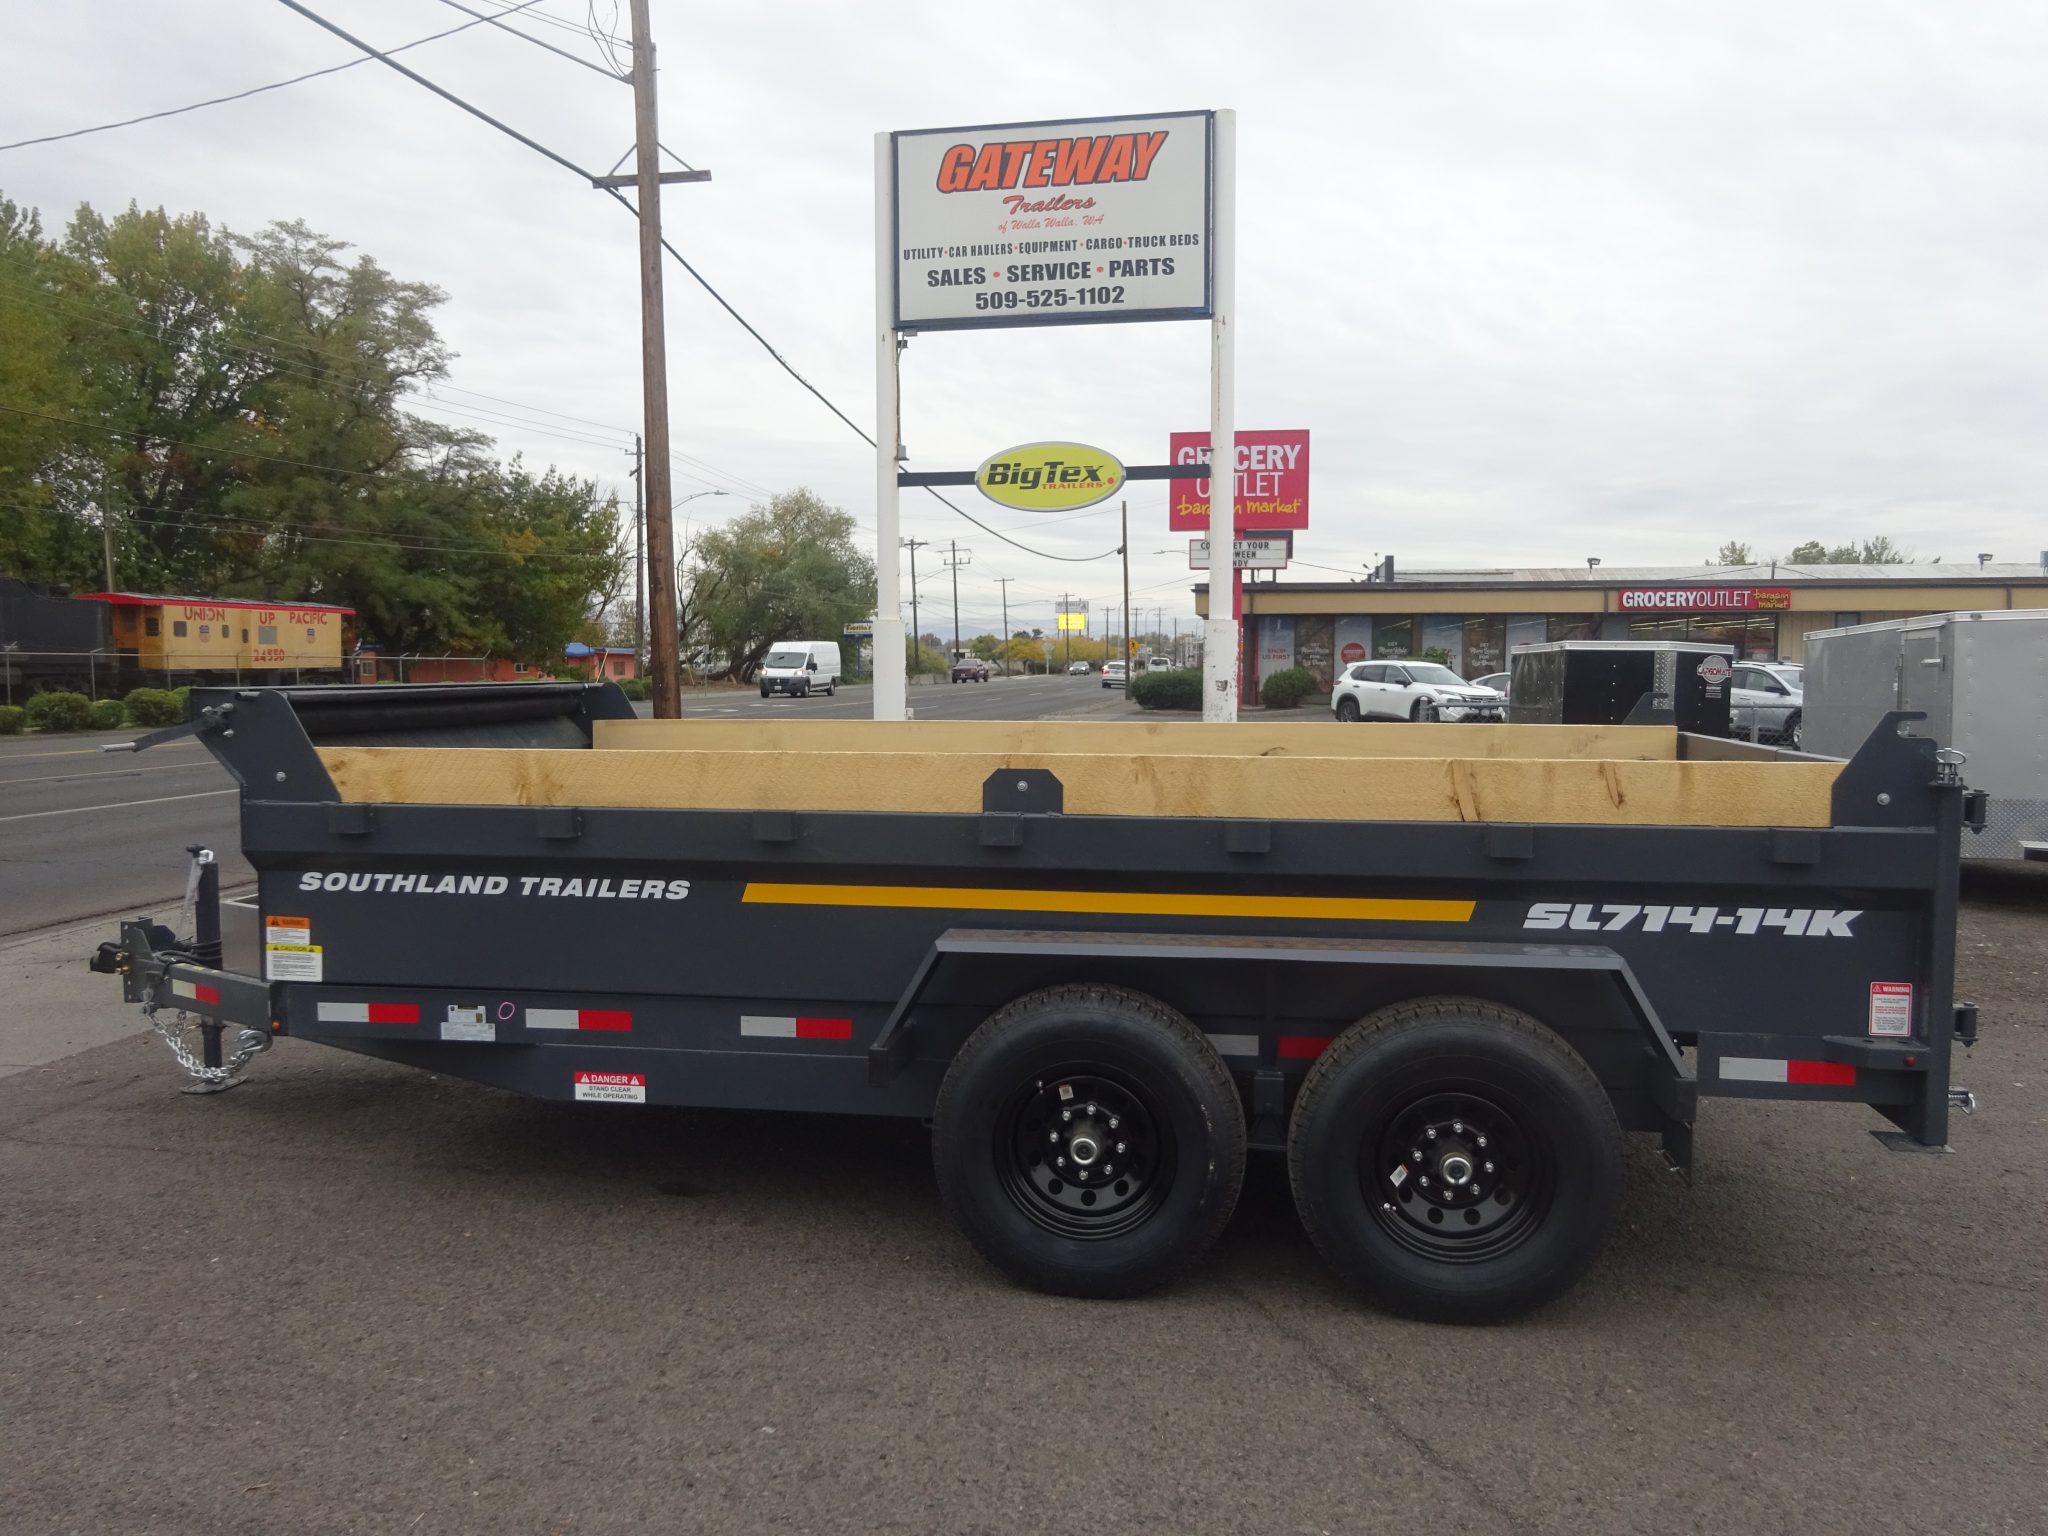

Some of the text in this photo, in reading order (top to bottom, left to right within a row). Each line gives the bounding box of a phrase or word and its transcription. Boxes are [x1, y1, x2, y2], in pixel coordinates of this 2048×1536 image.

[936, 130, 1169, 194] GATEWAY
[1003, 193, 1096, 215] Trailers
[998, 221, 1008, 233] of
[1010, 219, 1040, 231] Walla
[1082, 214, 1105, 226] WA
[948, 246, 968, 258] CAR
[970, 243, 1013, 257] HAULERS
[1018, 240, 1077, 254] EQUIPMENT
[1085, 237, 1122, 250] CARGO
[1128, 235, 1166, 248] TRUCK
[1169, 234, 1199, 246] BEDS
[927, 257, 1175, 287] SALES SERVICE PARTS
[975, 286, 1125, 310] 509-525-1102
[1177, 444, 1302, 471] GRCERY
[1041, 482, 1103, 490] TRAILERS
[1196, 471, 1284, 497] OTLET
[1246, 498, 1300, 514] market
[1247, 542, 1269, 550] YOUR
[1753, 588, 1789, 603] bargain
[1758, 600, 1788, 609] market
[184, 607, 225, 622] UNION
[259, 612, 276, 625] UP
[289, 611, 328, 625] PACIFIC
[299, 871, 691, 900] SOUTHLAND TRAILERS
[1522, 902, 1864, 938] SL714-14K
[1882, 985, 1910, 993] WARNING
[591, 1074, 628, 1084] DANGER
